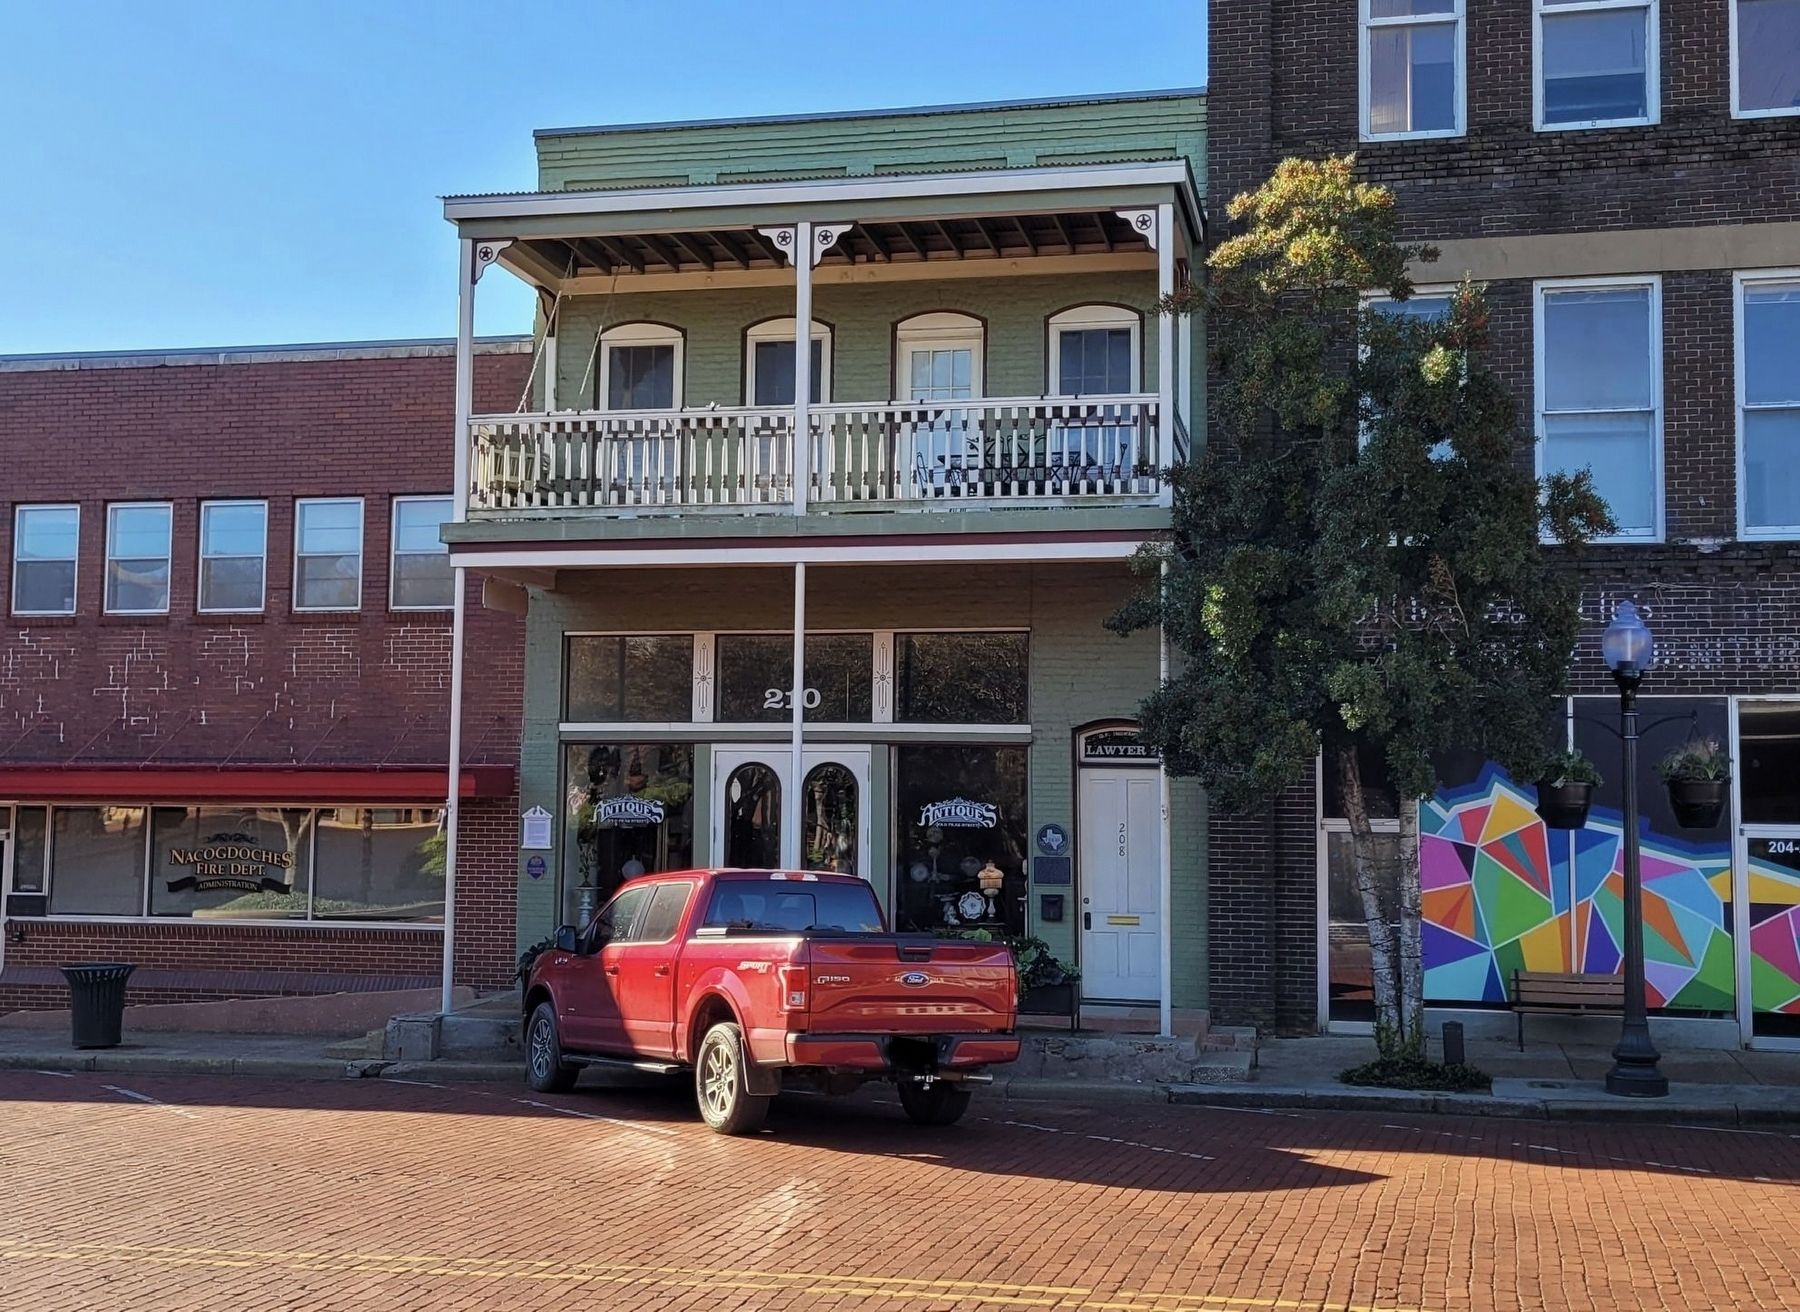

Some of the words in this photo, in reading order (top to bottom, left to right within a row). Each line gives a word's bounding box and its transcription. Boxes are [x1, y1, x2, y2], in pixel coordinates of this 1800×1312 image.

[1086, 745, 1147, 756] LAWYER
[589, 800, 664, 824] ANTIQUES
[917, 803, 997, 828] ANTIQUES
[1118, 823, 1126, 857] 208
[1768, 841, 1800, 853] 204-
[170, 846, 293, 868] NACOGDOCHES
[196, 862, 225, 875] FIRE
[230, 863, 267, 875] DEPT.
[199, 880, 258, 891] ADMINISTRATION
